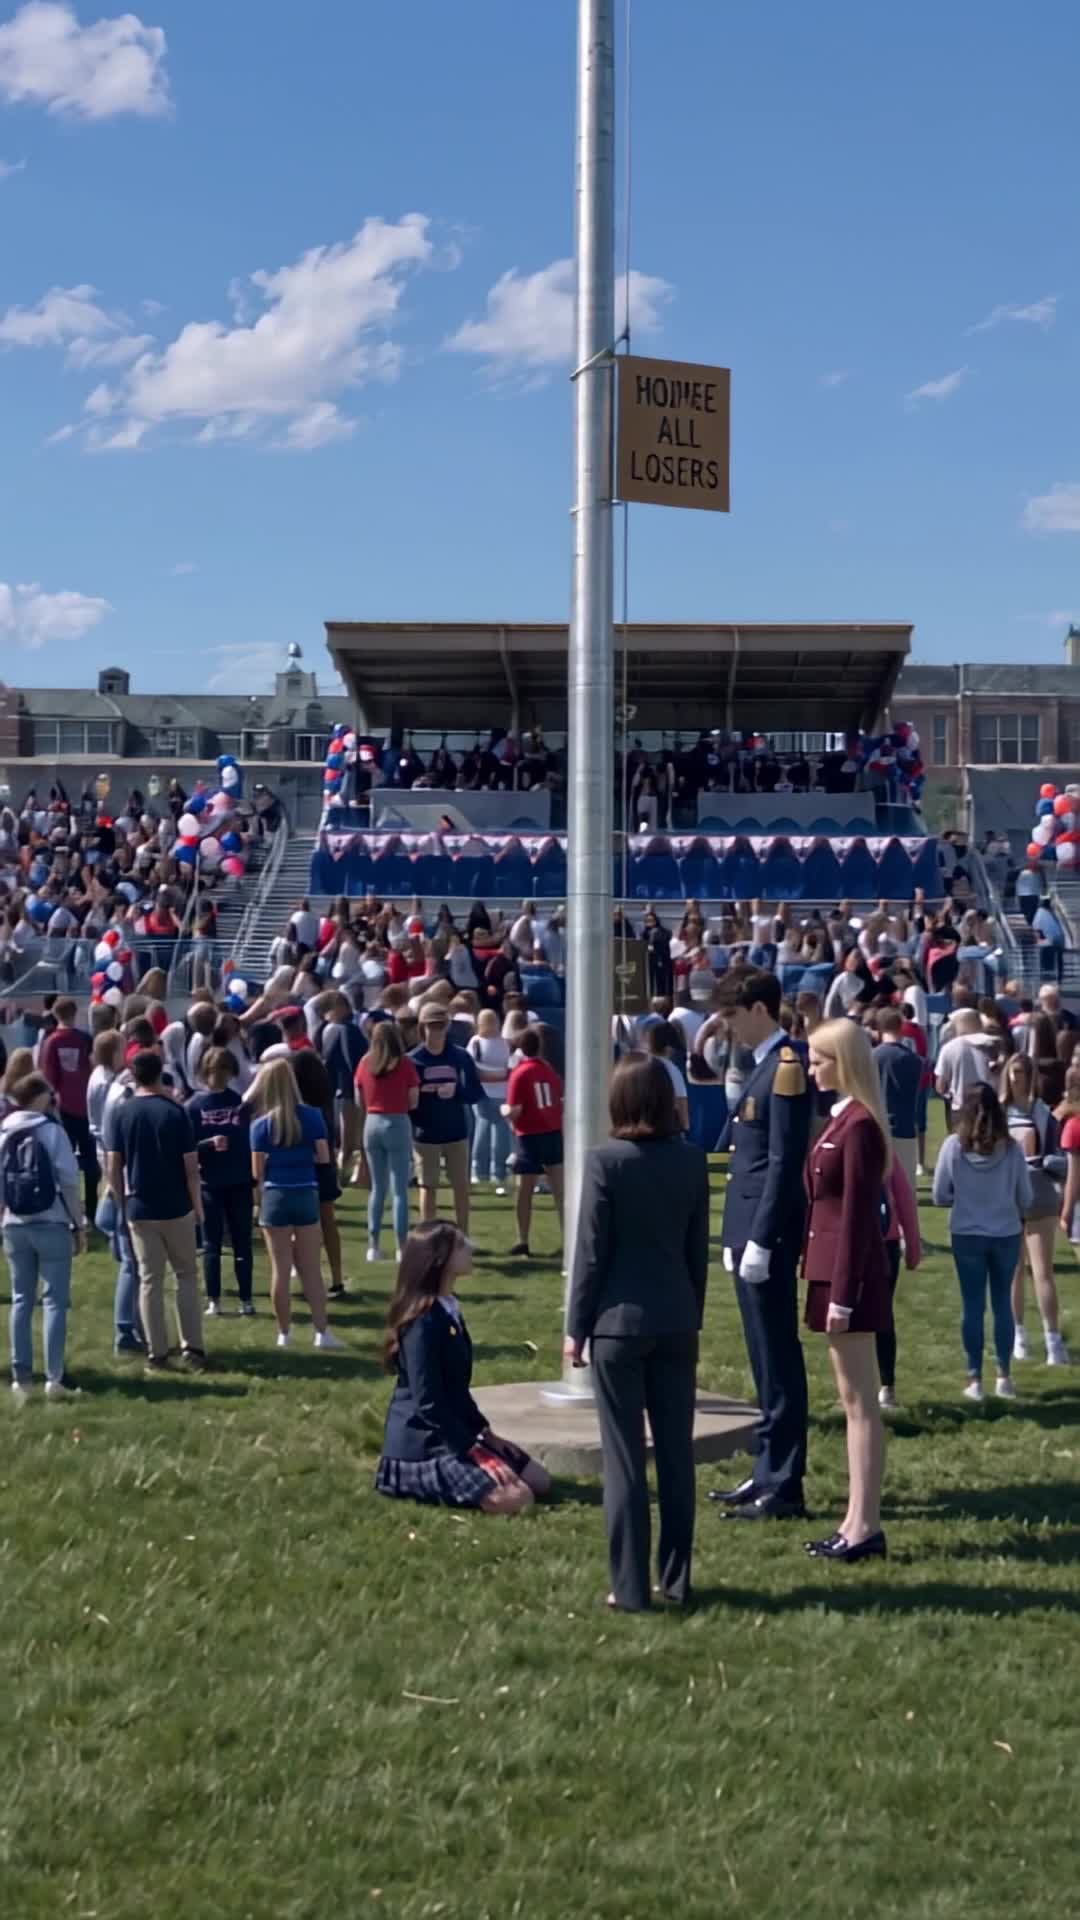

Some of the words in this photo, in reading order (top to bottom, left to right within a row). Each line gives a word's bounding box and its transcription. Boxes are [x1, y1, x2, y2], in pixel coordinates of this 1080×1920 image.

[657, 416, 702, 448] ALL
[631, 451, 719, 489] LOSERS
[534, 1082, 552, 1109] 11
